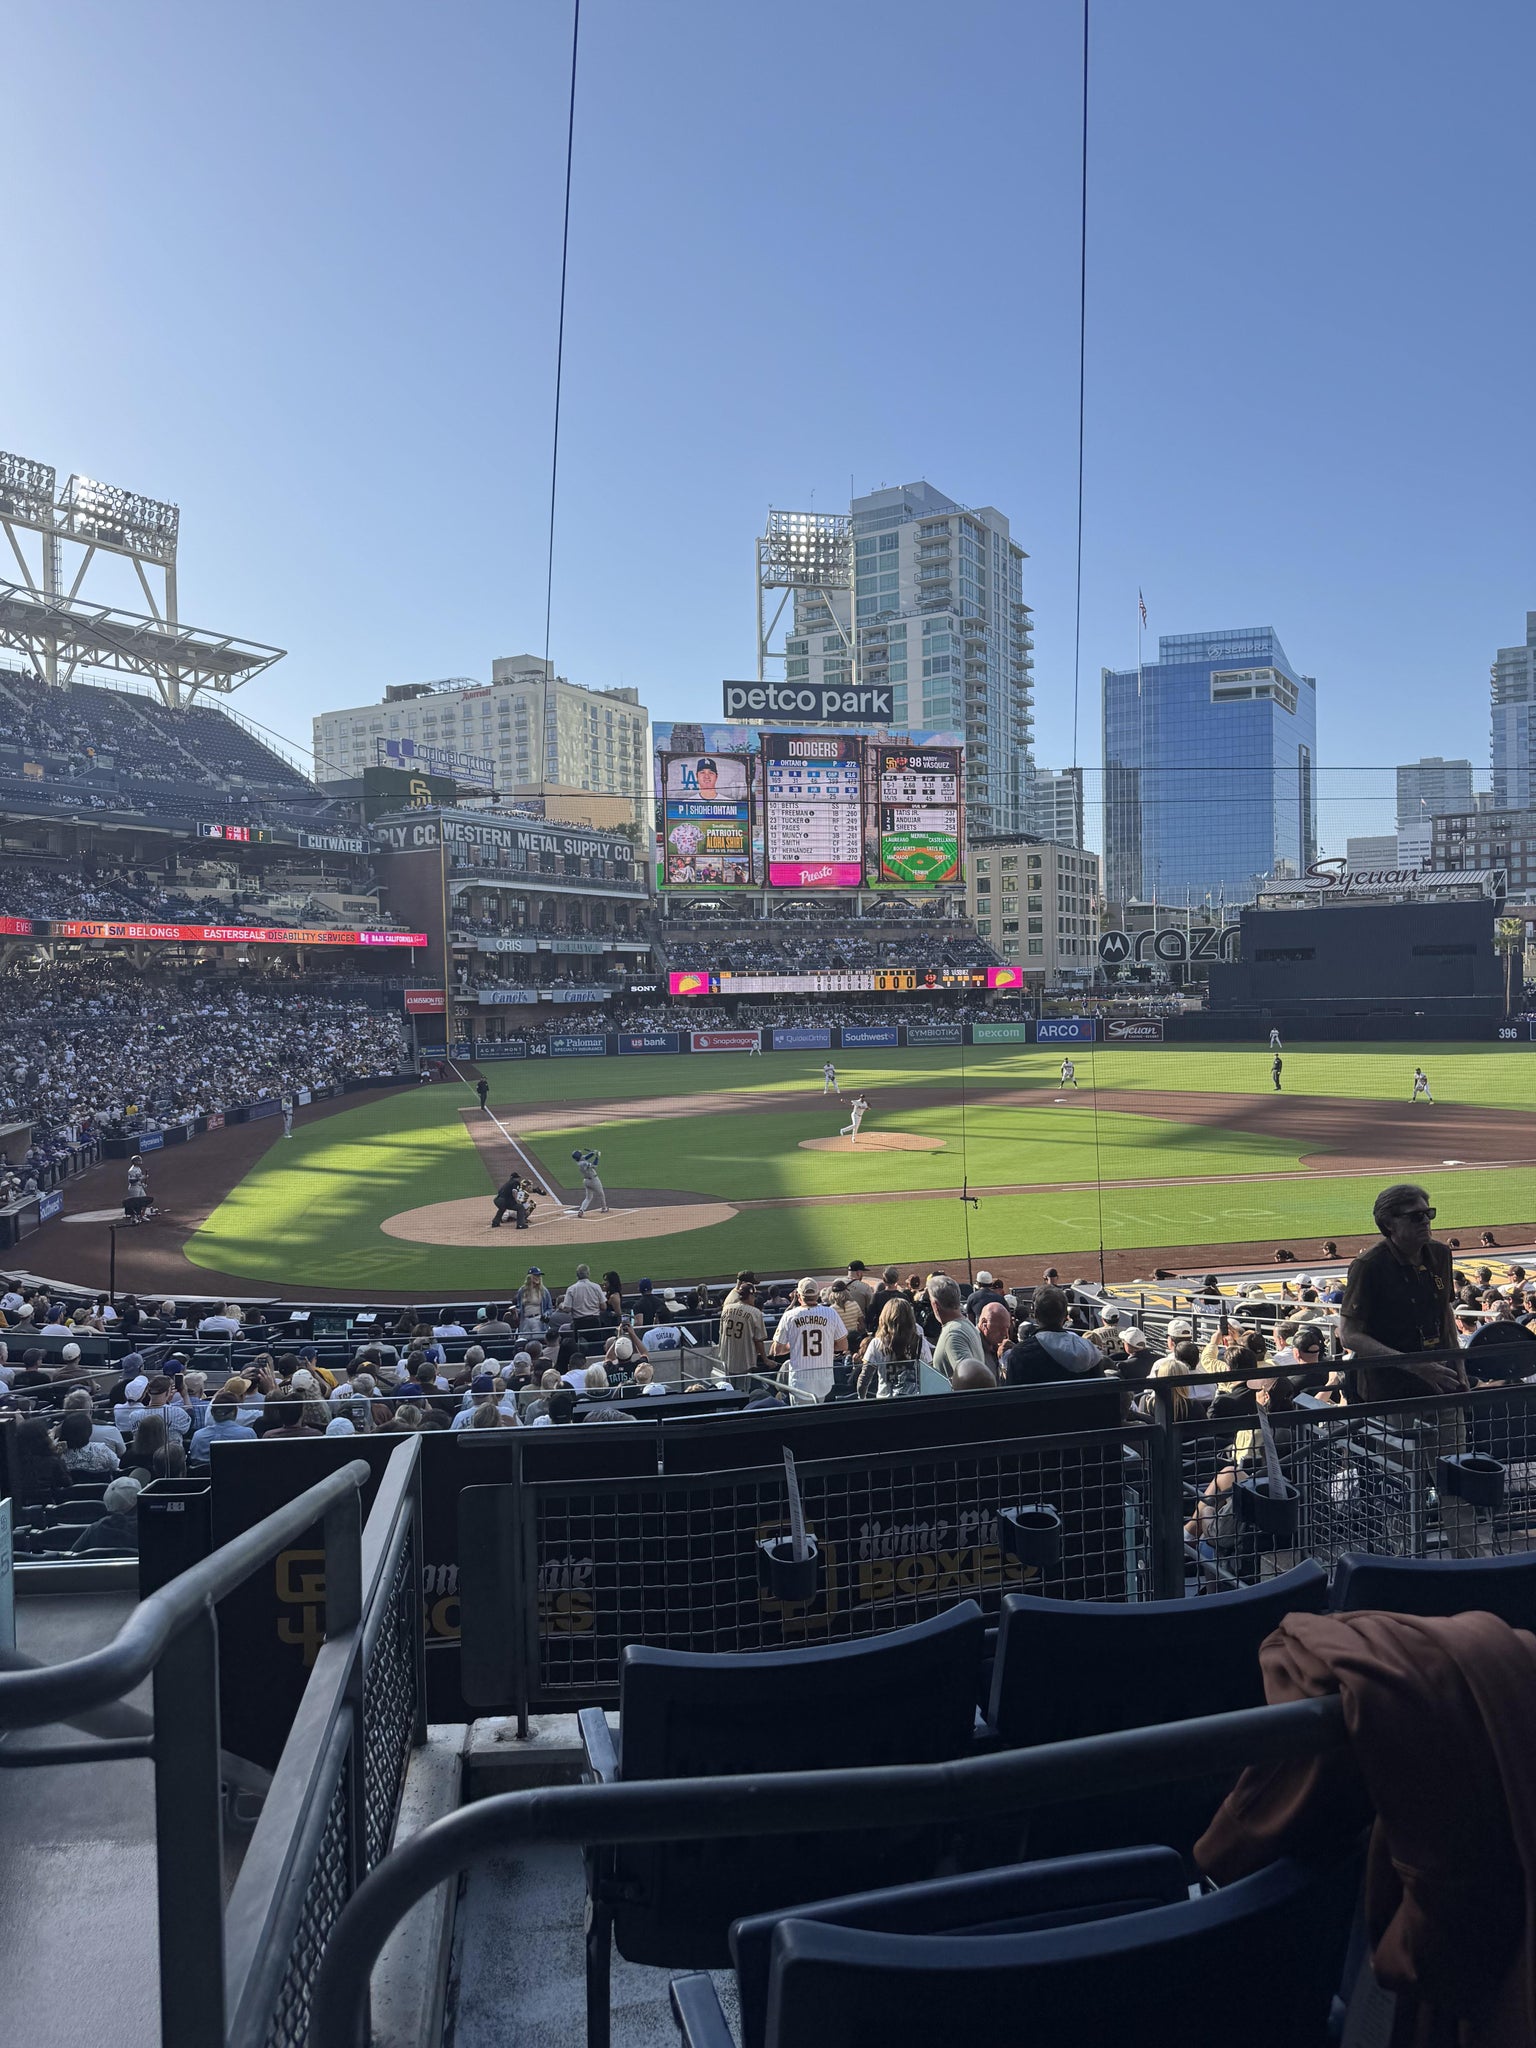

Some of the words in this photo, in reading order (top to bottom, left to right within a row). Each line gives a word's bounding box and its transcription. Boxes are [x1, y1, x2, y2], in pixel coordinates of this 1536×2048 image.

[1225, 643, 1268, 655] SEMPRA
[727, 684, 816, 716] petco
[822, 689, 890, 719] park
[788, 741, 838, 757] DODGERS
[910, 757, 922, 767] 98
[678, 805, 684, 814] P
[690, 805, 712, 815] SHOHEI
[713, 806, 737, 816] OHTANI
[412, 825, 440, 846] CO.
[308, 835, 362, 852] CUTWATER
[442, 822, 512, 848] WESTERN
[518, 834, 560, 854] METAL
[564, 839, 609, 862] SUPPLY
[614, 846, 634, 862] CO.
[726, 836, 743, 848] SHIRT
[798, 865, 833, 884] Puesto
[1305, 858, 1422, 896] Sycuan
[80, 924, 126, 936] AUTISM
[129, 926, 180, 938] BELONGS
[204, 929, 266, 940] EASTERSEALS
[268, 932, 316, 942] DISABILITY
[318, 934, 355, 942] SERVICES
[496, 940, 522, 951] ORIS
[1134, 924, 1240, 962] razr
[880, 976, 886, 988] 0
[894, 976, 899, 988] 0
[907, 976, 912, 988] 0
[491, 992, 528, 1002] Canel's
[563, 990, 596, 1002] Canel's
[454, 1006, 468, 1016] 336
[909, 1029, 960, 1037] CYMBIOTIKA
[1039, 1024, 1079, 1037] ARCO
[1108, 1022, 1158, 1039] Sycuan
[1498, 1028, 1518, 1039] 396
[566, 1038, 604, 1048] Palomar
[644, 1038, 666, 1046] bank
[712, 1037, 752, 1046] Snapdragon
[786, 1034, 828, 1043] QuidelOrtho
[845, 1032, 888, 1042] Southwest
[530, 1044, 546, 1055] 342
[794, 1315, 828, 1328] MACHADO
[726, 1321, 744, 1339] 23
[802, 1329, 822, 1356] 13
[608, 1372, 628, 1383] TATIS
[858, 1519, 948, 1560] Home
